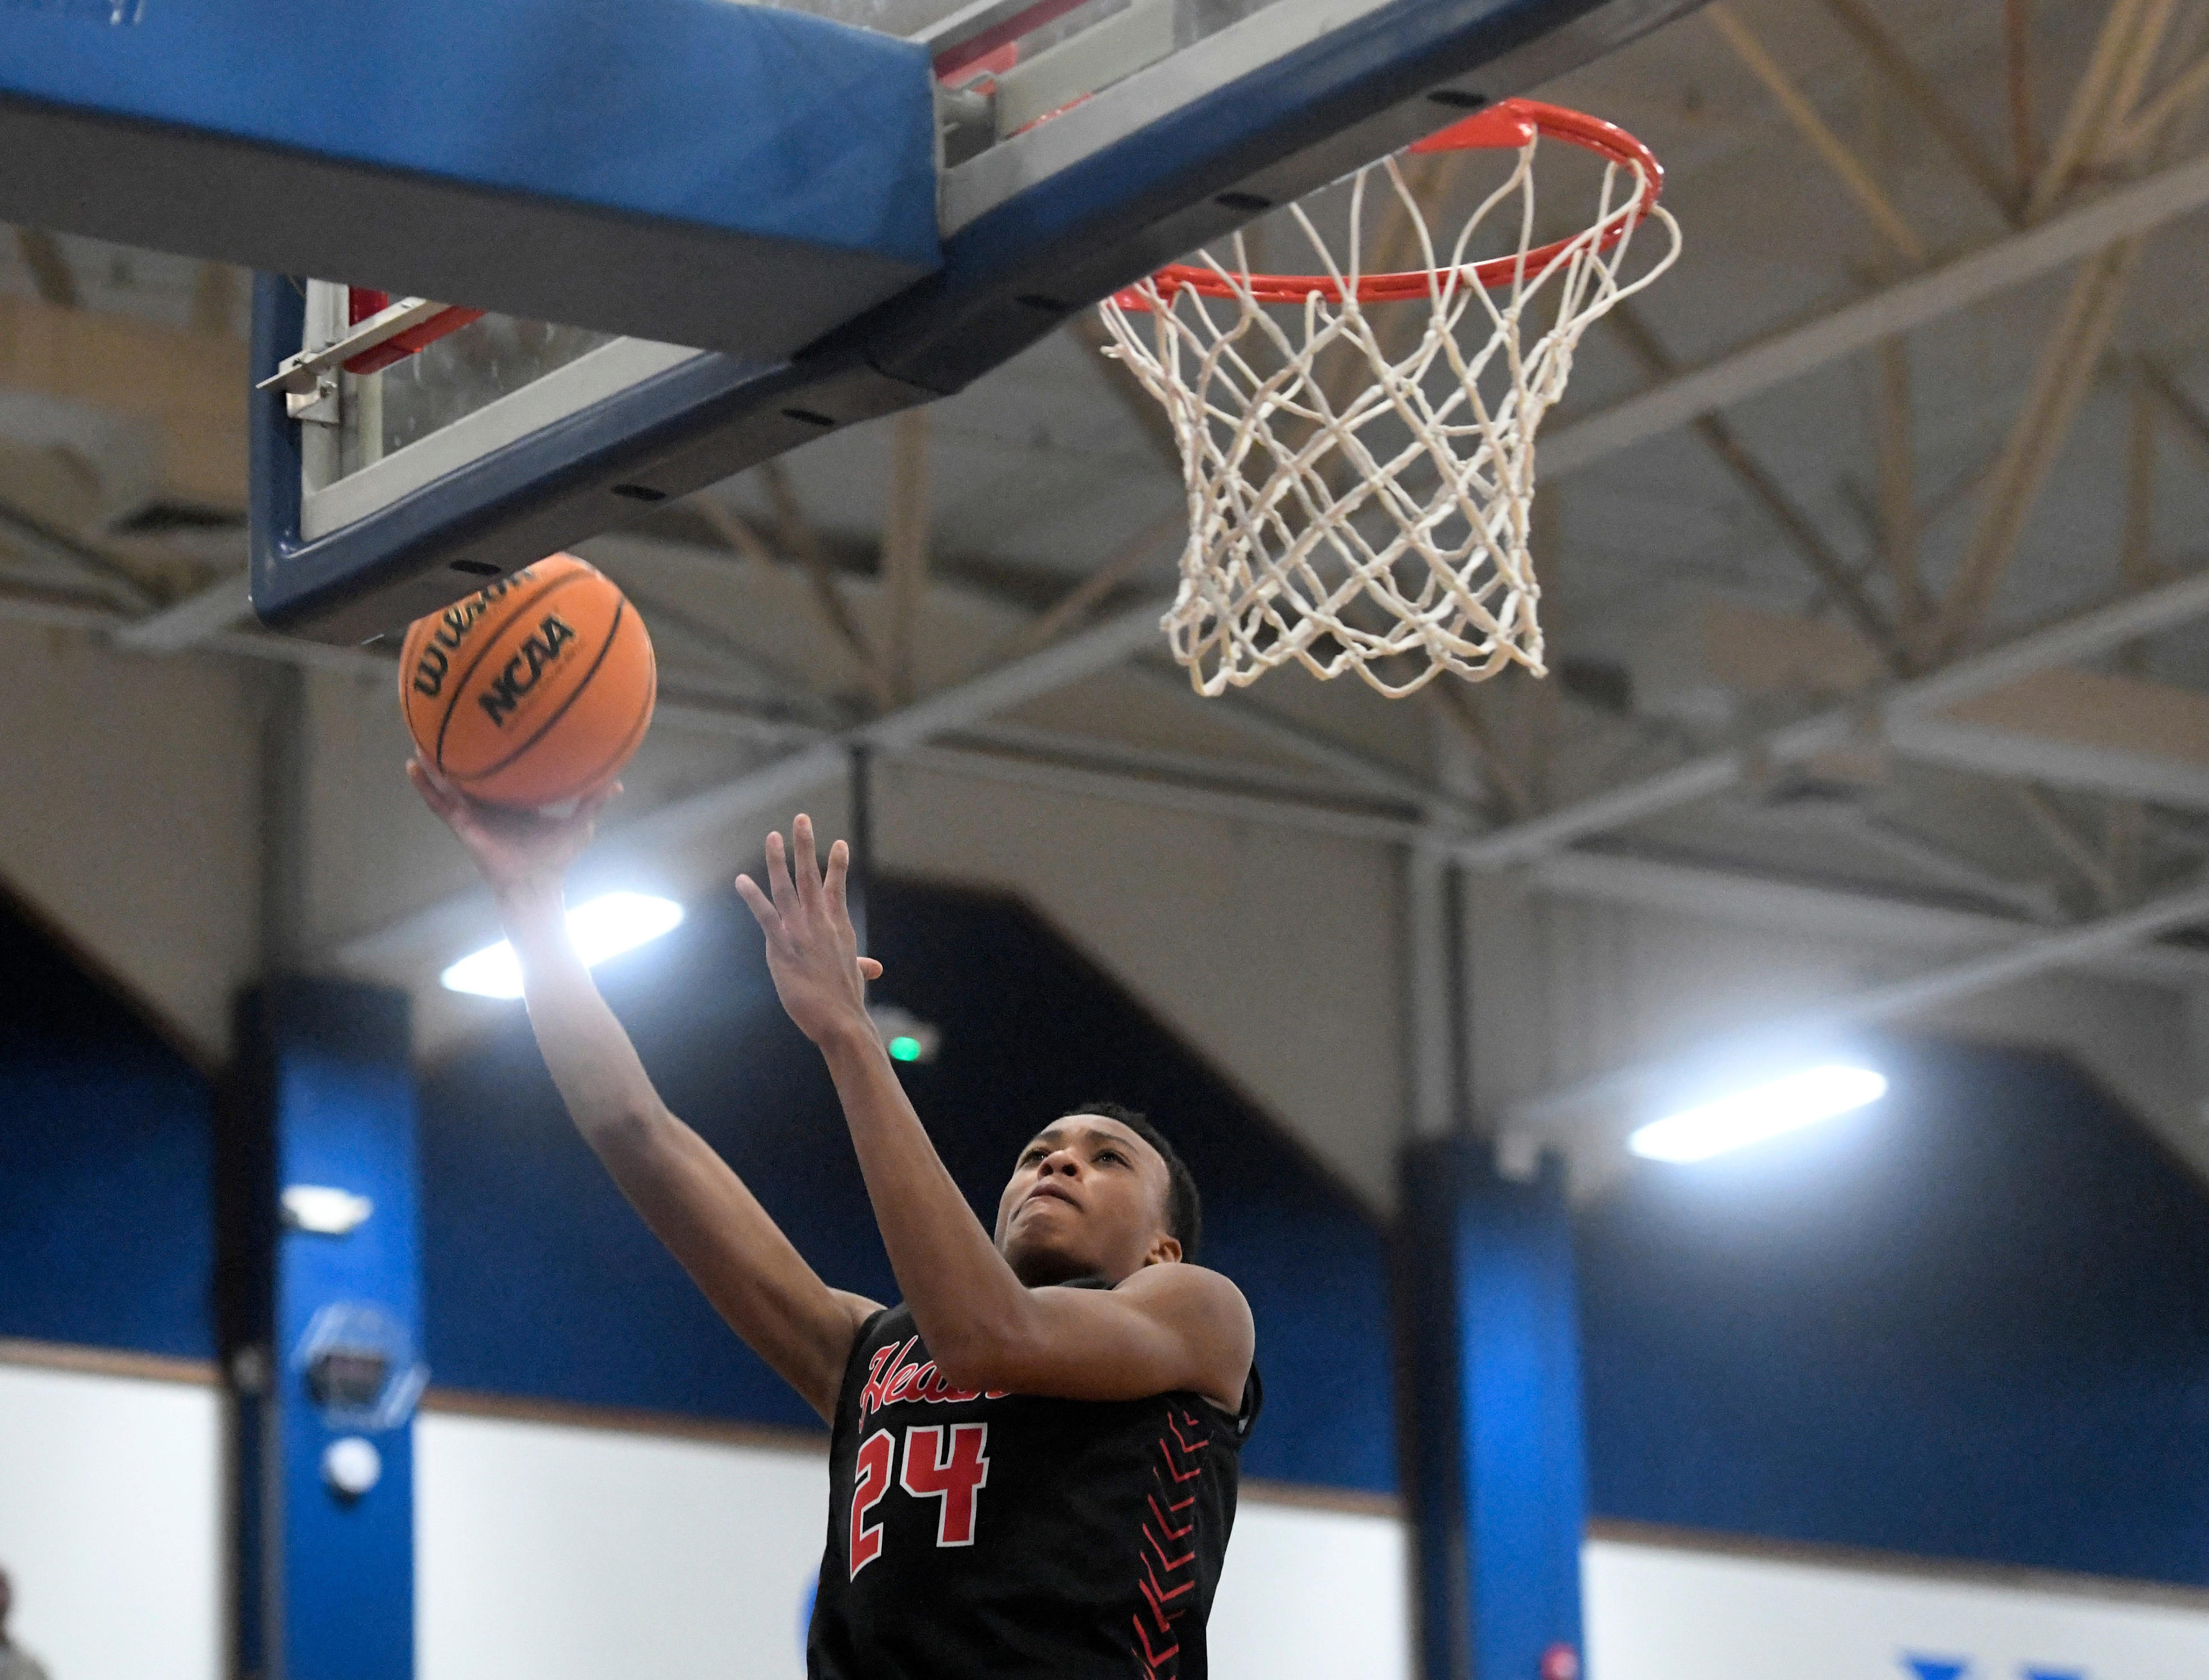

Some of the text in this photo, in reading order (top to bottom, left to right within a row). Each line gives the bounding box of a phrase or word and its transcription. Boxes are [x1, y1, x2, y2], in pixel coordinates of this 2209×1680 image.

[478, 616, 574, 728] NCAA
[859, 1335, 1011, 1434] Hea
[850, 1423, 990, 1582] 24
